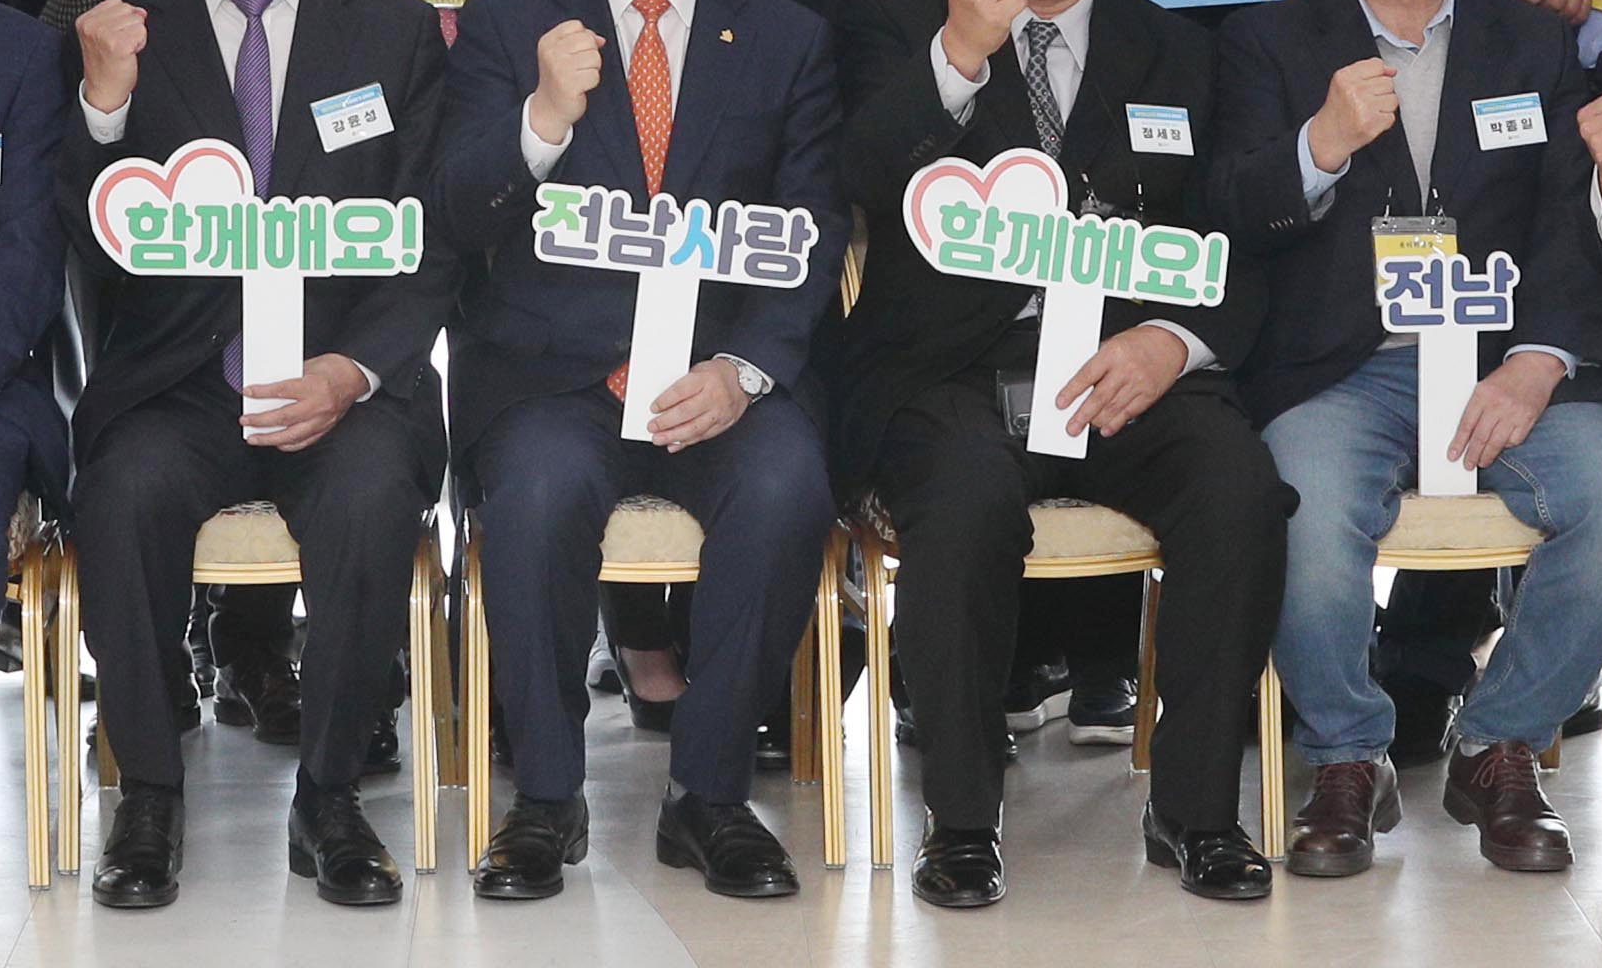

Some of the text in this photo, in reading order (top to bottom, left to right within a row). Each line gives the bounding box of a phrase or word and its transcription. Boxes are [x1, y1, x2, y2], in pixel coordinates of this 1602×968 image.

[126, 201, 418, 271] 함께해요!
[537, 190, 811, 281] 전남사랑
[938, 200, 1221, 299] 함께해요!
[1384, 255, 1518, 326] 전남
